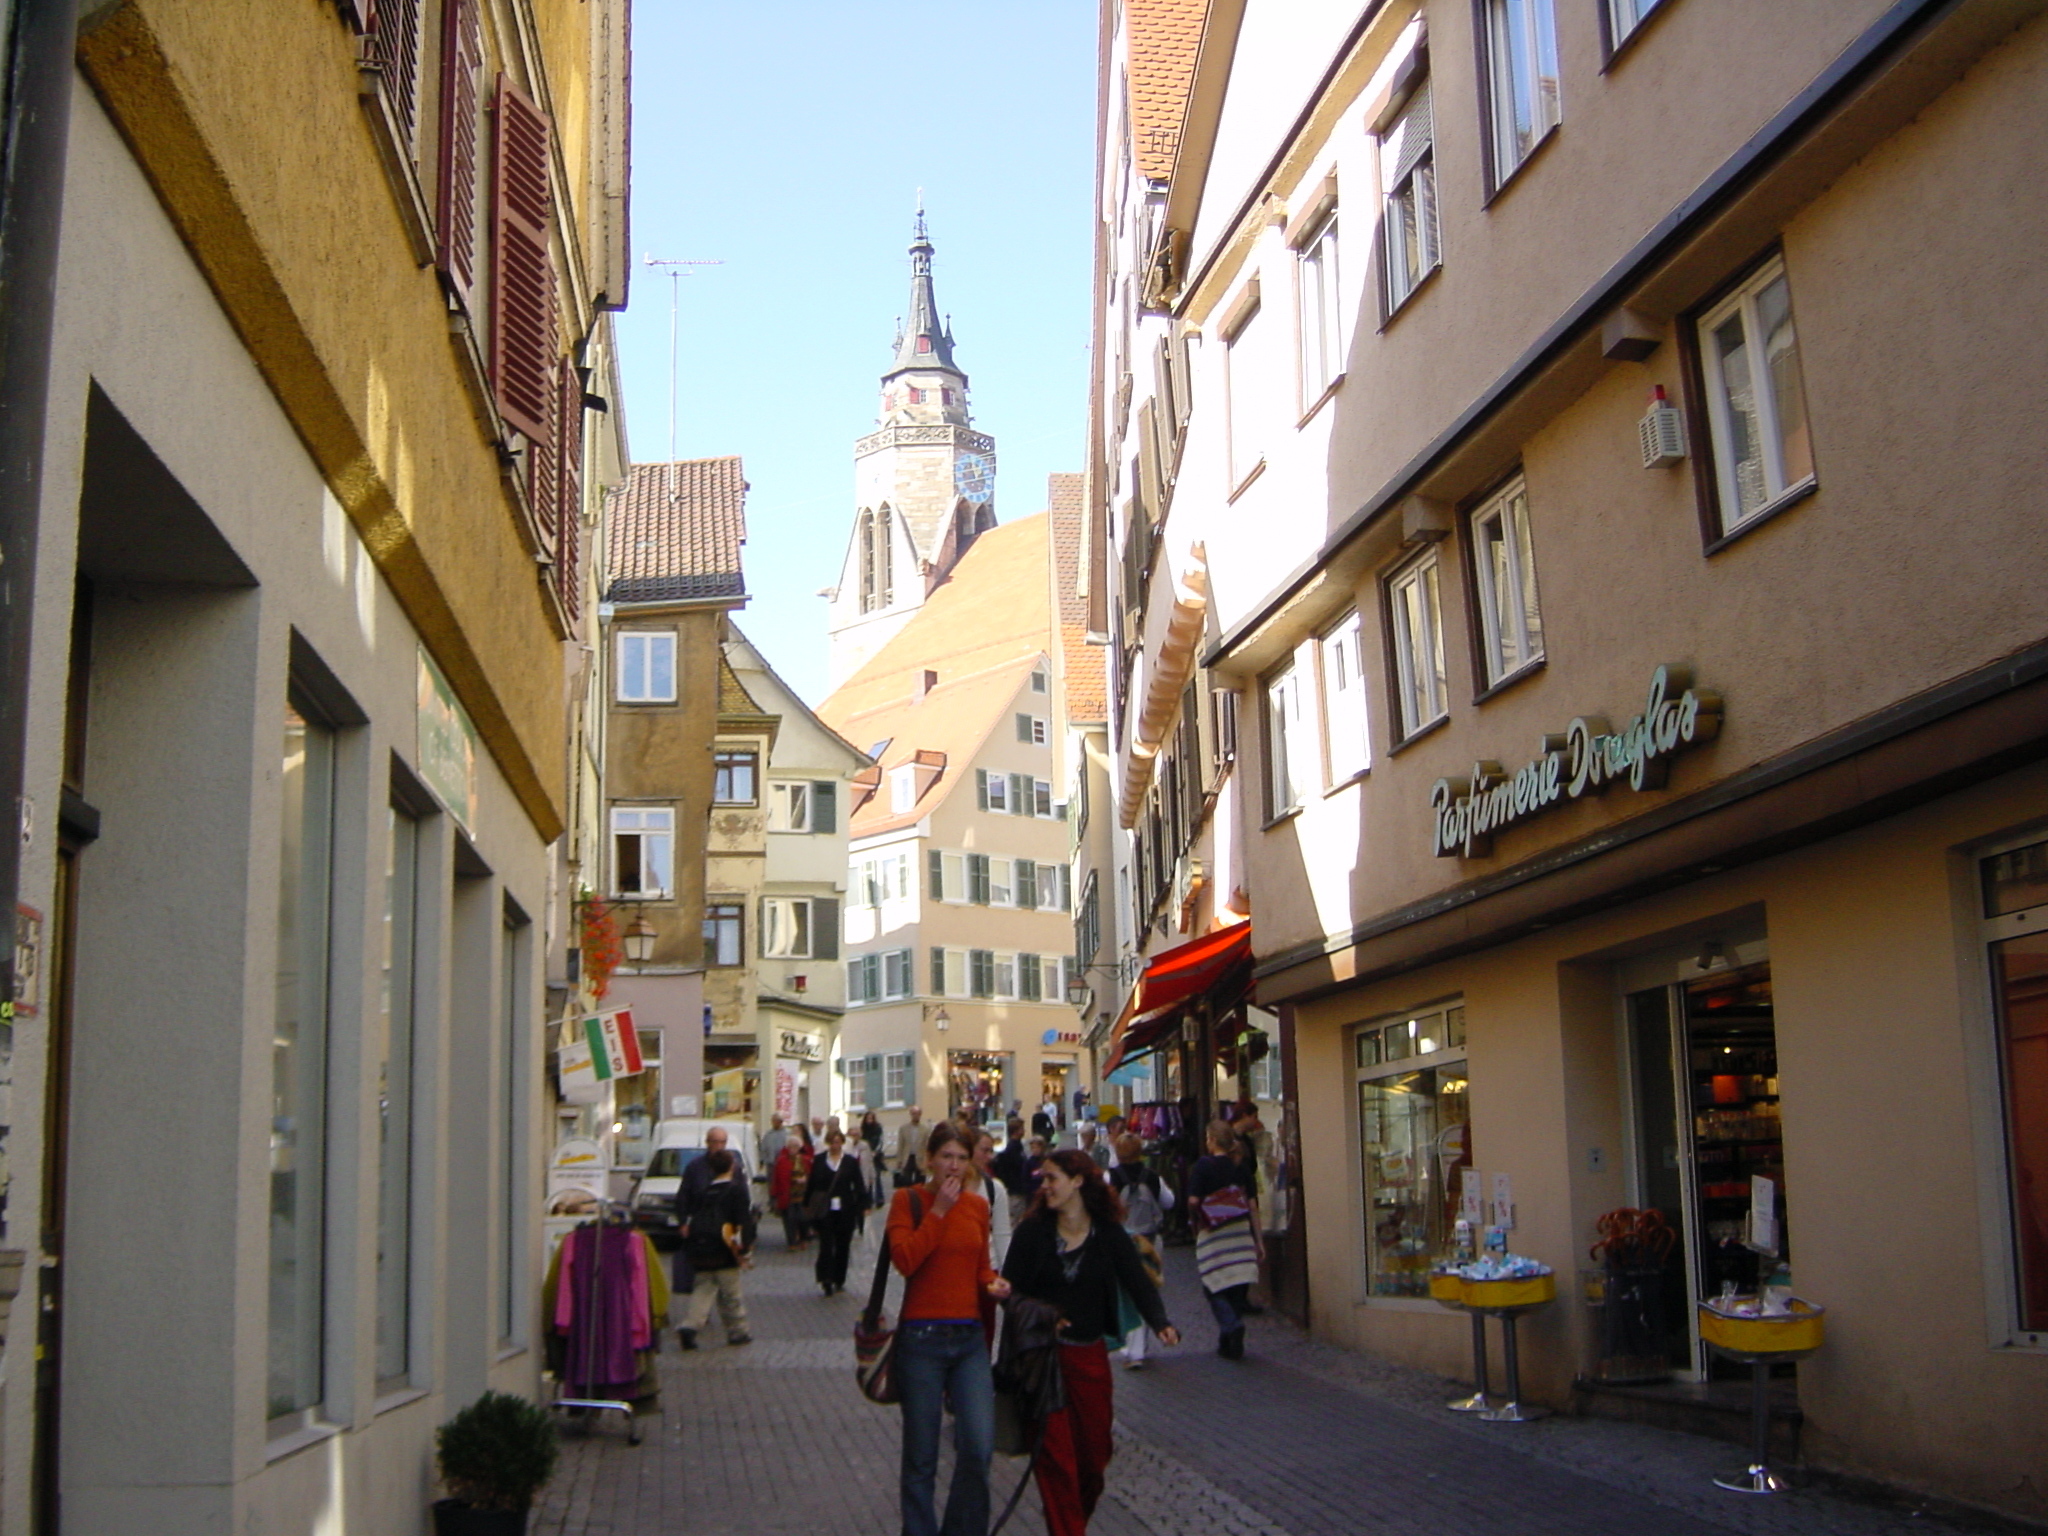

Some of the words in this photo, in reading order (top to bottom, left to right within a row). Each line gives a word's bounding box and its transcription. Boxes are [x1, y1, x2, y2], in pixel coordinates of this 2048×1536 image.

[1431, 735, 1561, 858] Parfümerie
[1567, 662, 1703, 797] Douglas
[604, 1019, 624, 1072] EIS
